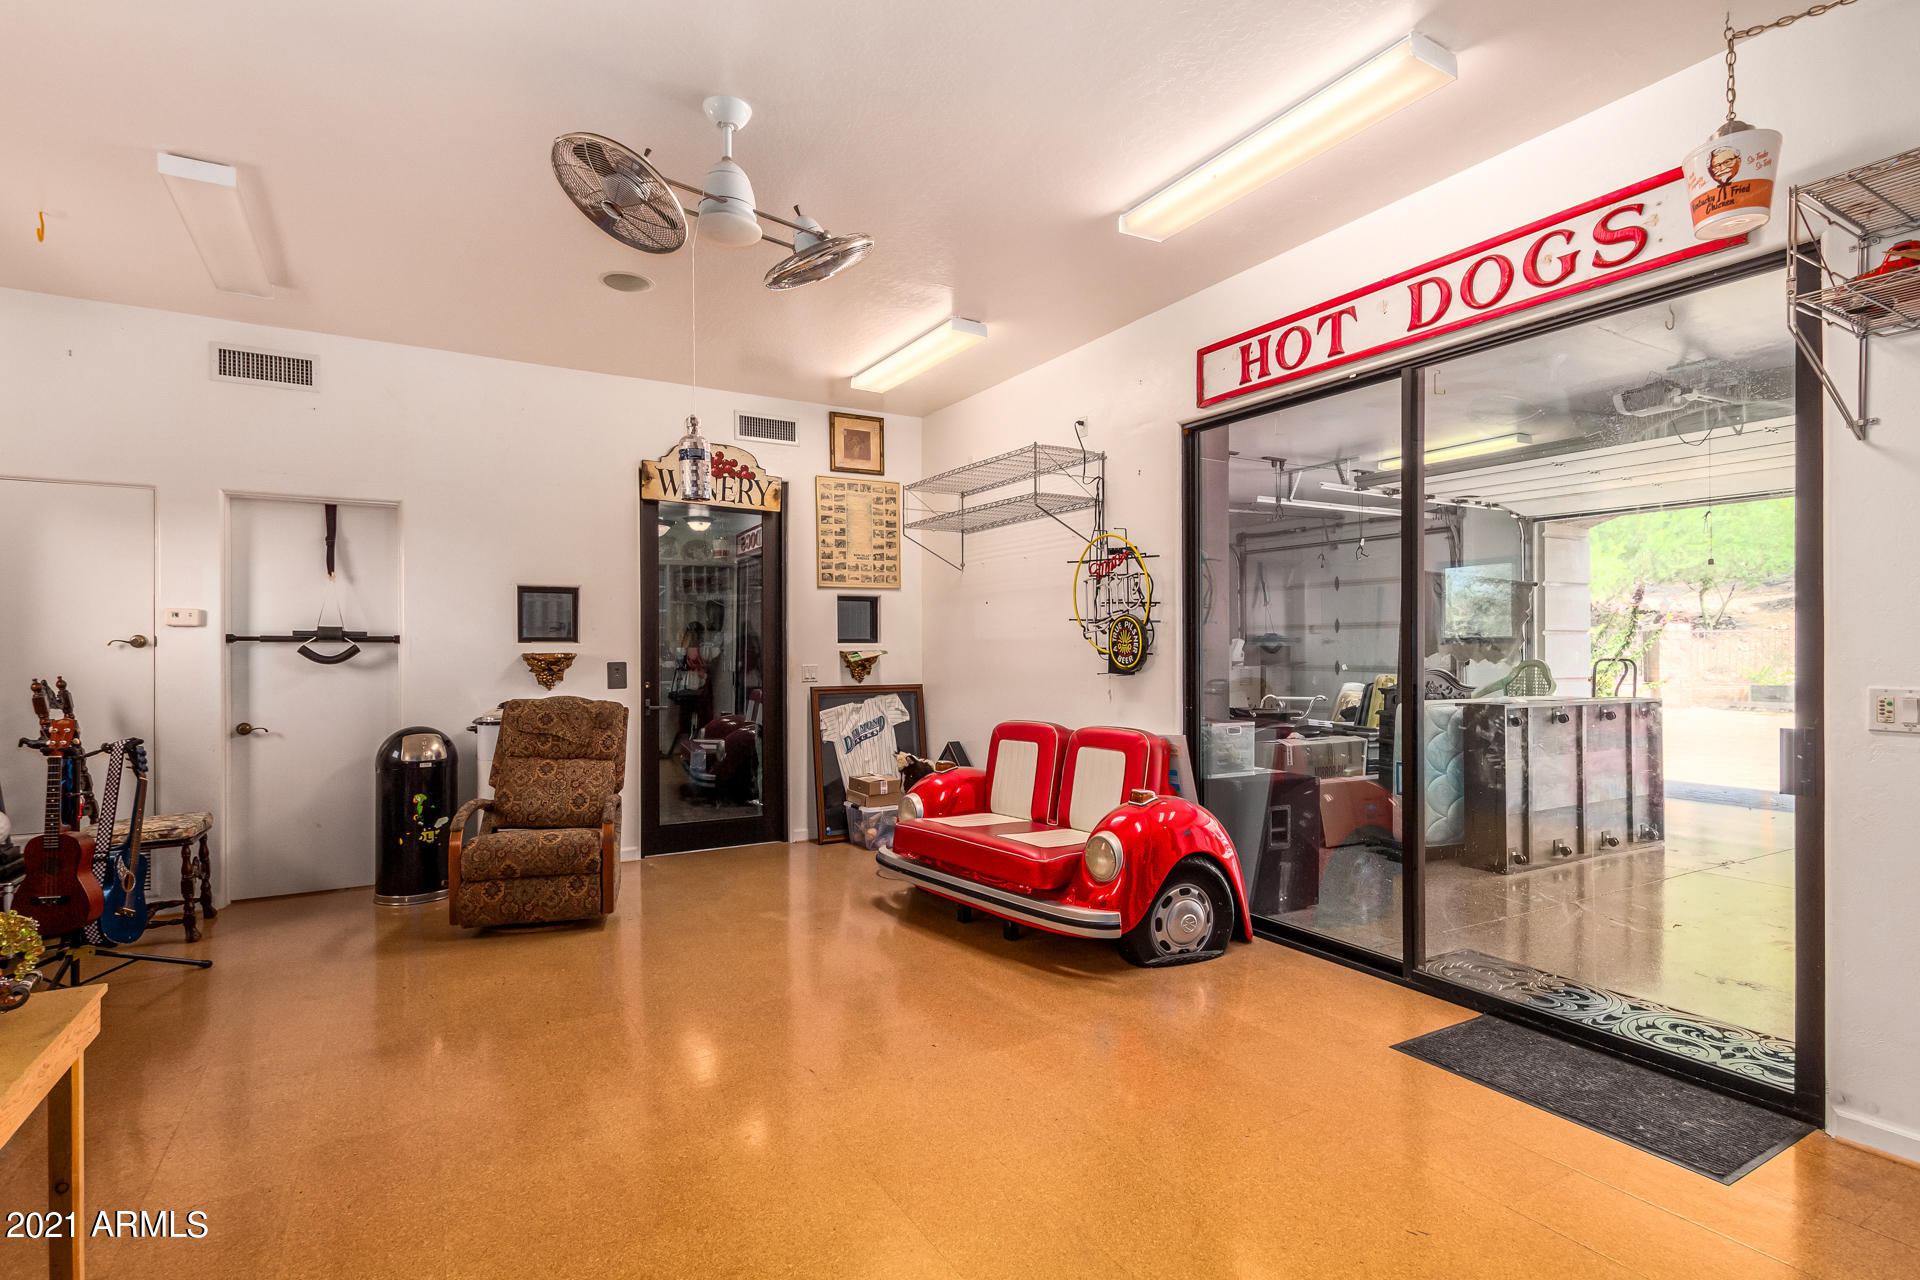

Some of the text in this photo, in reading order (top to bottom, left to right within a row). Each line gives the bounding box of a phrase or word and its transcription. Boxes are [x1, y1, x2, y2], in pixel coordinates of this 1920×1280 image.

[1692, 183, 1751, 213] Kentucky Fried
[1705, 198, 1735, 215] Chicken
[1238, 203, 1649, 386] HOT DOGS
[1089, 550, 1130, 579] Miller
[1112, 622, 1123, 642] TRUE
[1124, 620, 1139, 654] PILSNER
[1117, 655, 1134, 664] BEER
